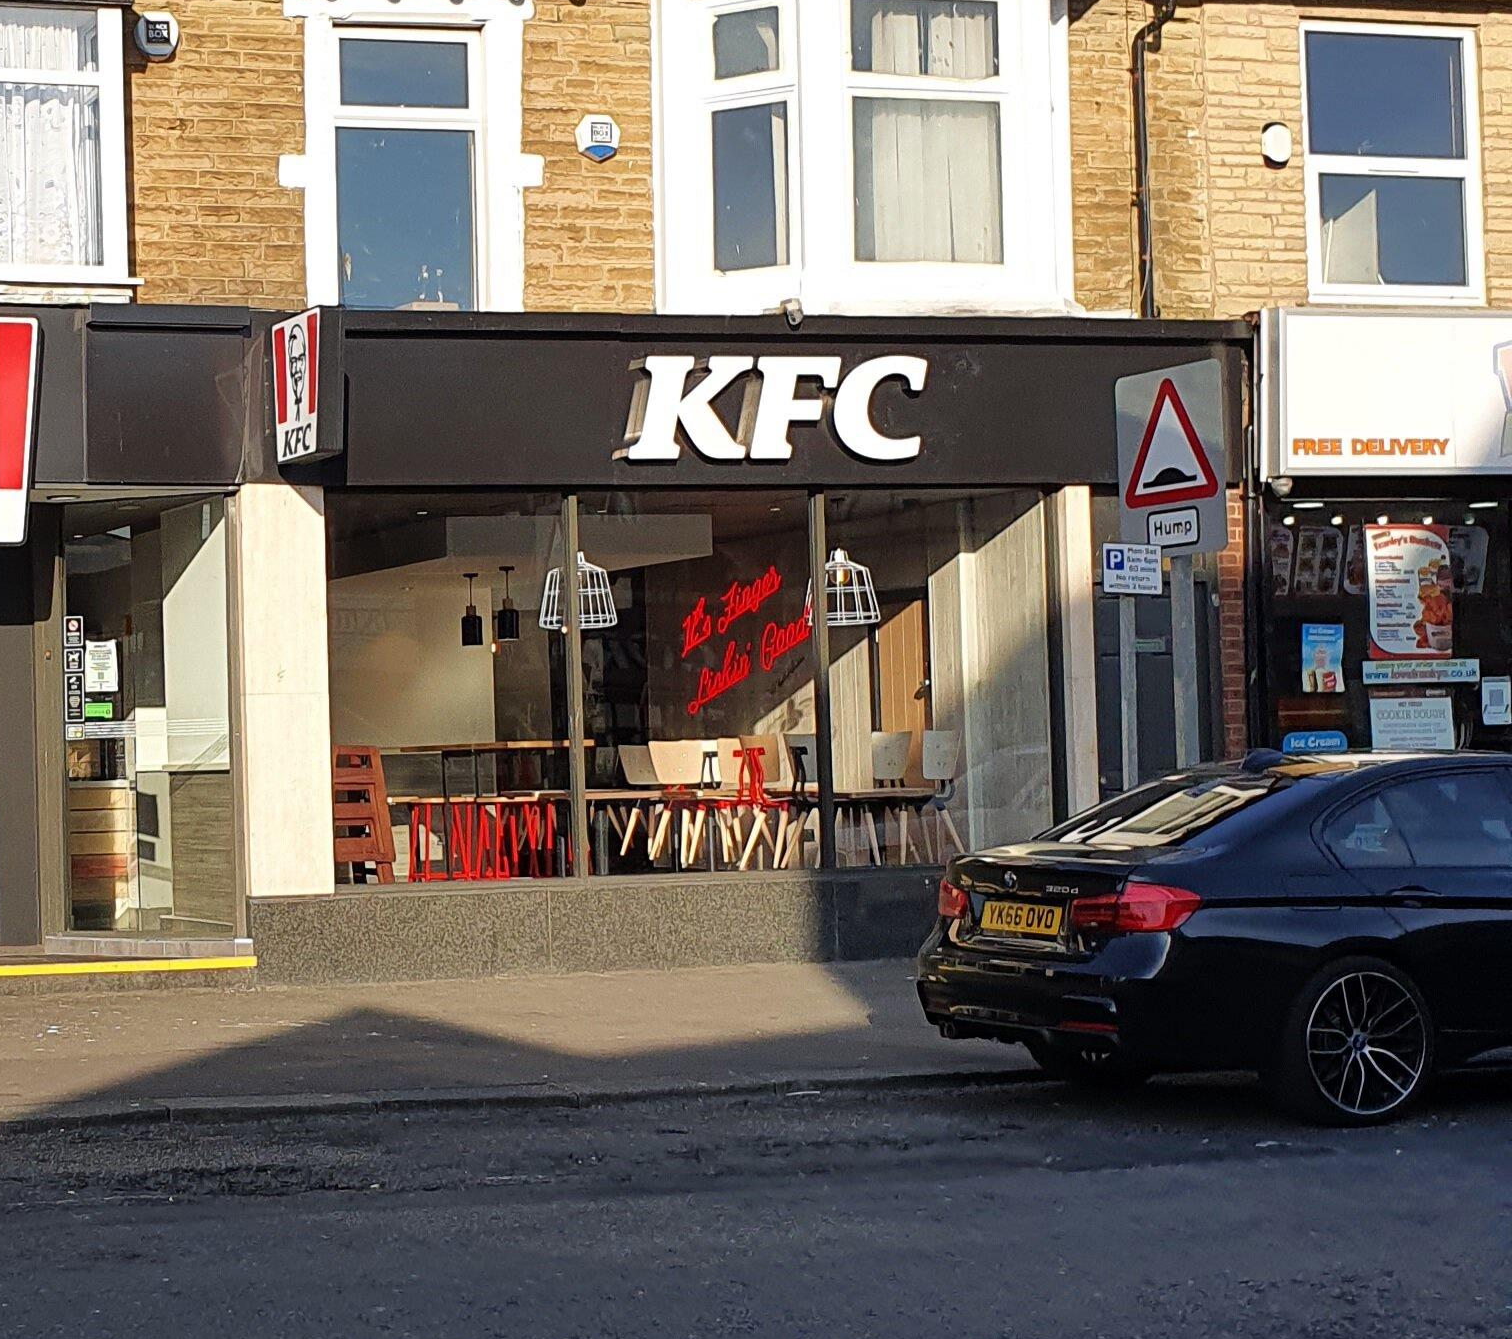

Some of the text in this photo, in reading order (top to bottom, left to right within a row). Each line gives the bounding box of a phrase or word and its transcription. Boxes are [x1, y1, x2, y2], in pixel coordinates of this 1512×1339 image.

[148, 30, 168, 38] BOX
[626, 355, 929, 461] KFC
[282, 422, 312, 458] KFC
[1293, 437, 1450, 456] FREE DELIVERY
[1153, 520, 1193, 537] Hump
[1109, 551, 1123, 569] P
[717, 565, 782, 634] Finger
[1290, 737, 1341, 748] Ice Cream
[989, 904, 1023, 925] YK66
